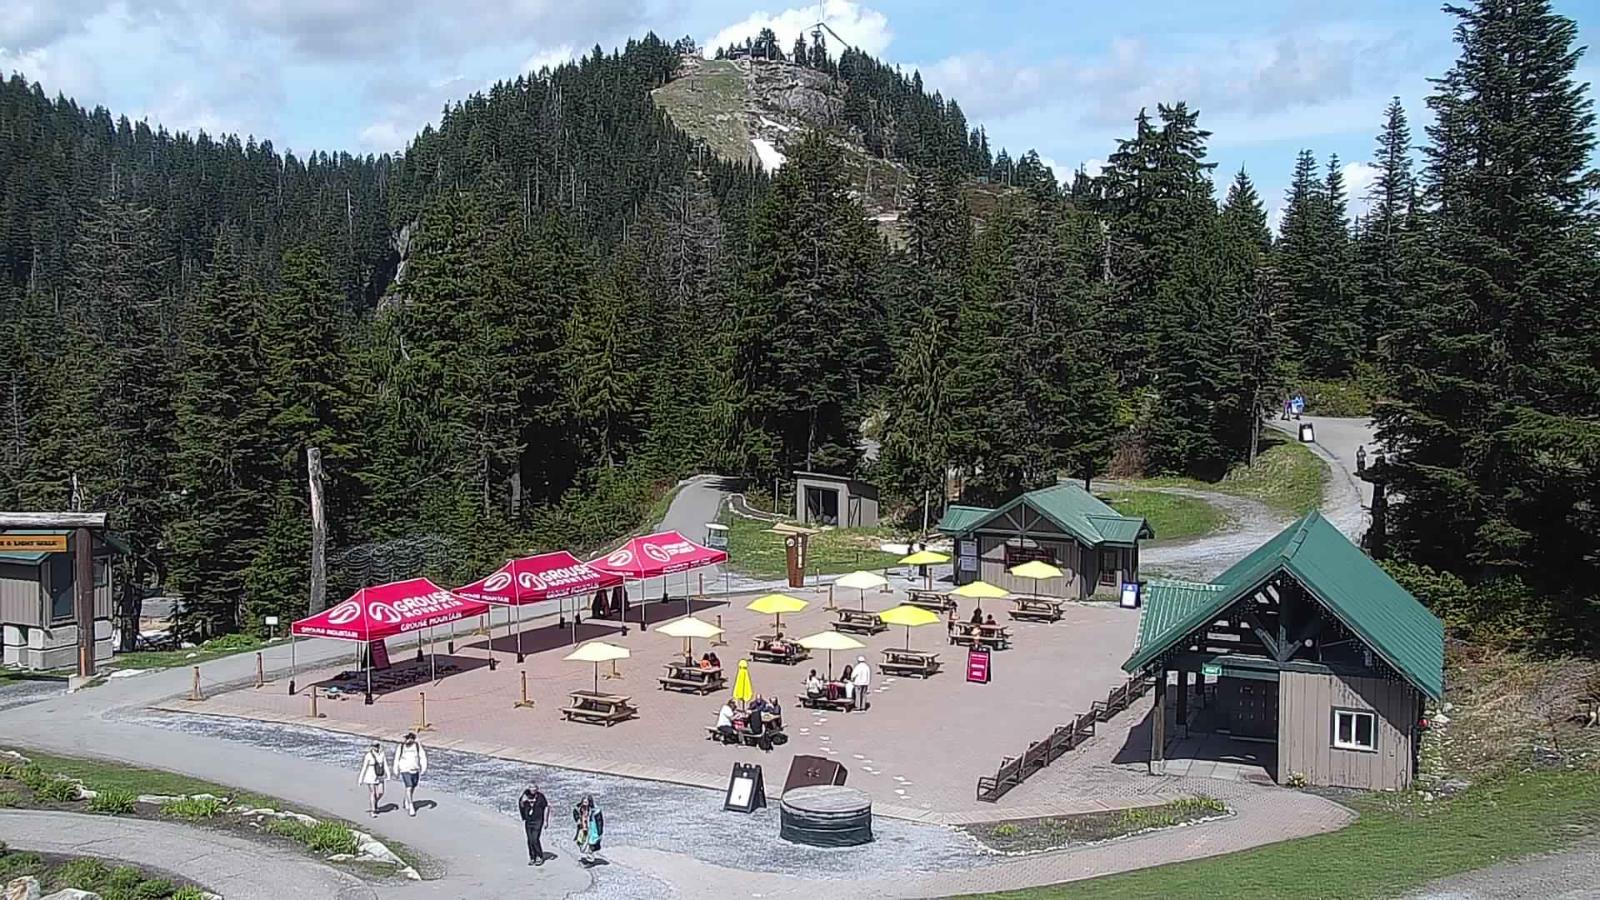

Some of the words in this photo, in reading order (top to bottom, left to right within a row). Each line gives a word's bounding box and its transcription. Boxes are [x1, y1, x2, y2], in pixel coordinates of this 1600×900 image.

[540, 564, 593, 582] GROUSE
[393, 590, 453, 613] GROUSE
[403, 600, 464, 619] MOUNTAIN
[401, 620, 428, 632] GROUSE
